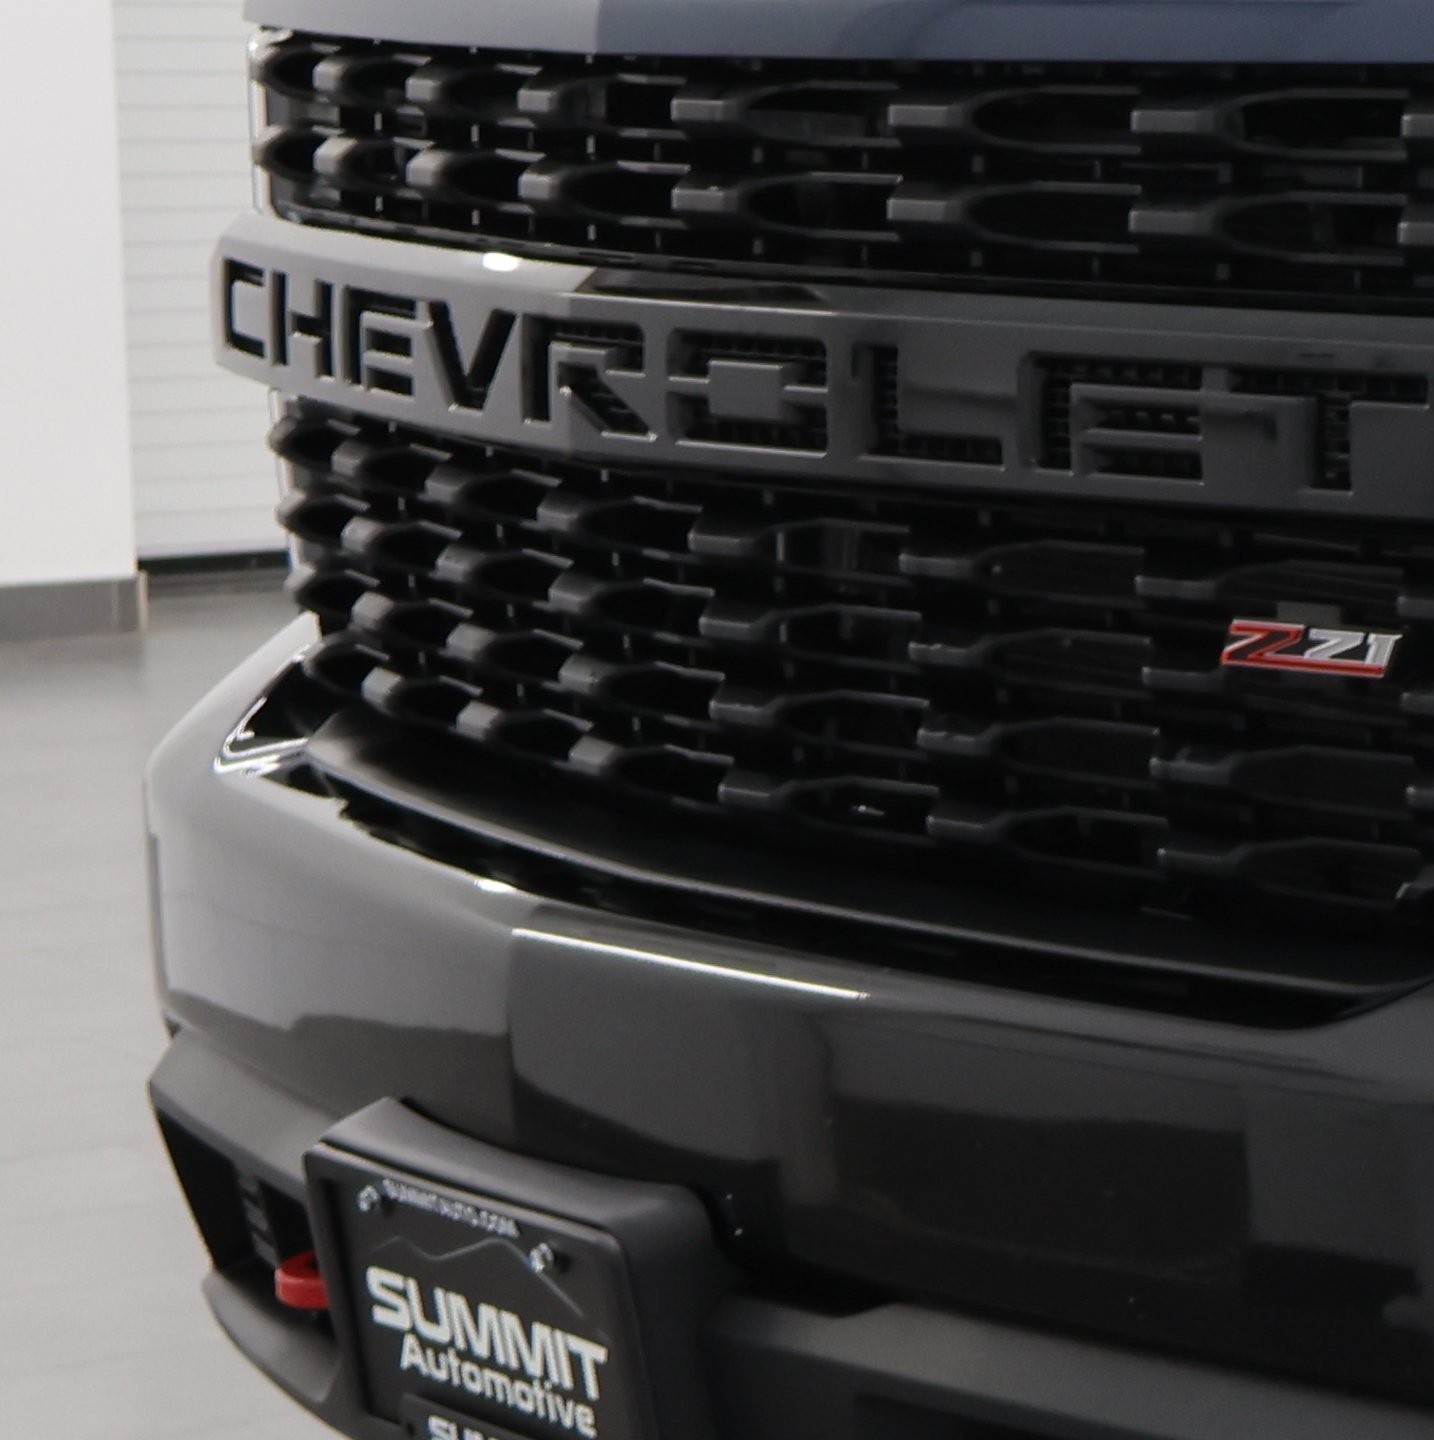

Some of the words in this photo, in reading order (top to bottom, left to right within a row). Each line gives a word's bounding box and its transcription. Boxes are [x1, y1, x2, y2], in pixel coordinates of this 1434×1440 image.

[222, 255, 1430, 496] CHEVROLET
[1220, 619, 1403, 678] Z71
[366, 1266, 607, 1400] SUMMIT
[400, 1334, 597, 1438] Automotive
